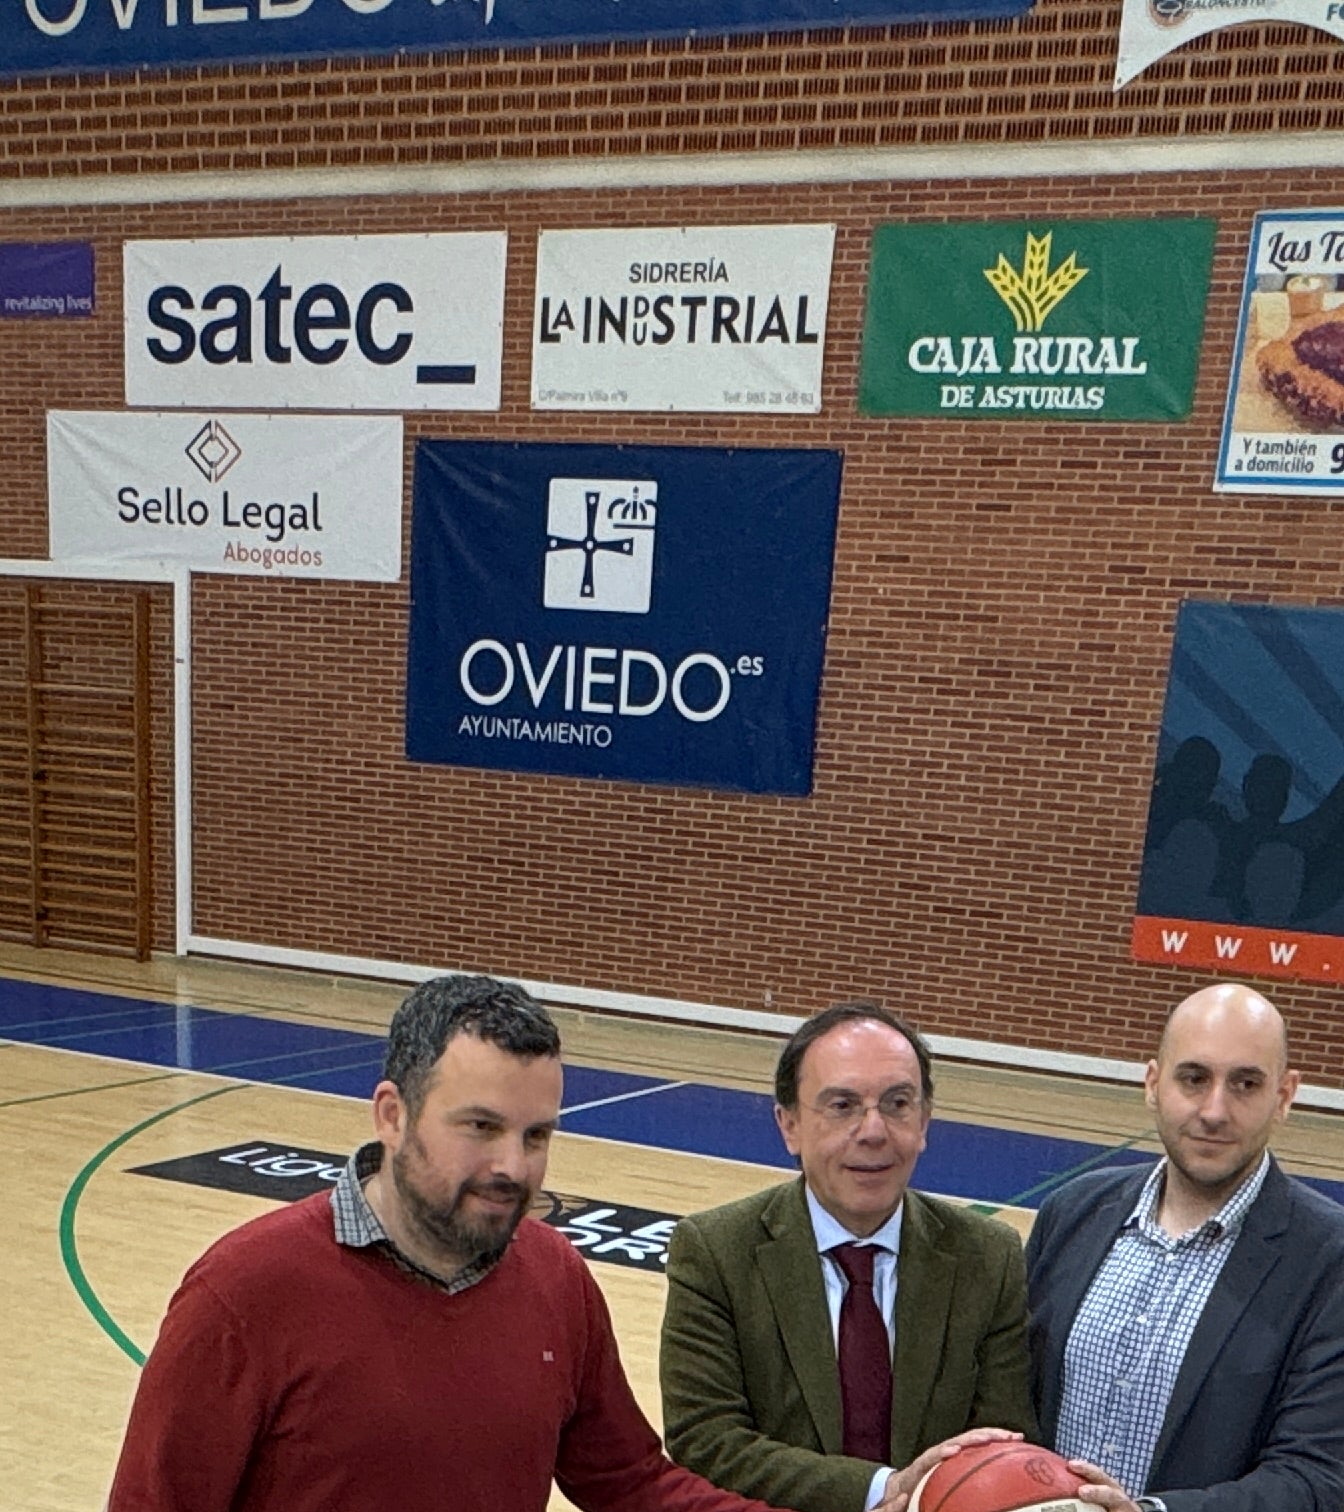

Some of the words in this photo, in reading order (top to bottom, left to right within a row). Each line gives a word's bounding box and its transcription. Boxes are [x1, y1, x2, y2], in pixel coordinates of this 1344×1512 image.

[1268, 231, 1312, 271] Las
[629, 257, 729, 284] SIDRERÍA
[540, 296, 575, 344] LA
[908, 337, 1002, 377] CAJA
[1010, 337, 1148, 375] RURAL
[940, 385, 975, 408] DE
[979, 385, 1105, 410] ASTURIAS
[1242, 438, 1254, 455] Y
[1255, 438, 1317, 457] también
[1234, 460, 1244, 472] a
[1246, 456, 1315, 474] domicilio
[117, 486, 210, 527] Sello
[222, 491, 323, 542] Legal
[223, 541, 323, 570] Abogados
[458, 715, 613, 749] AYUNTAMIENTO
